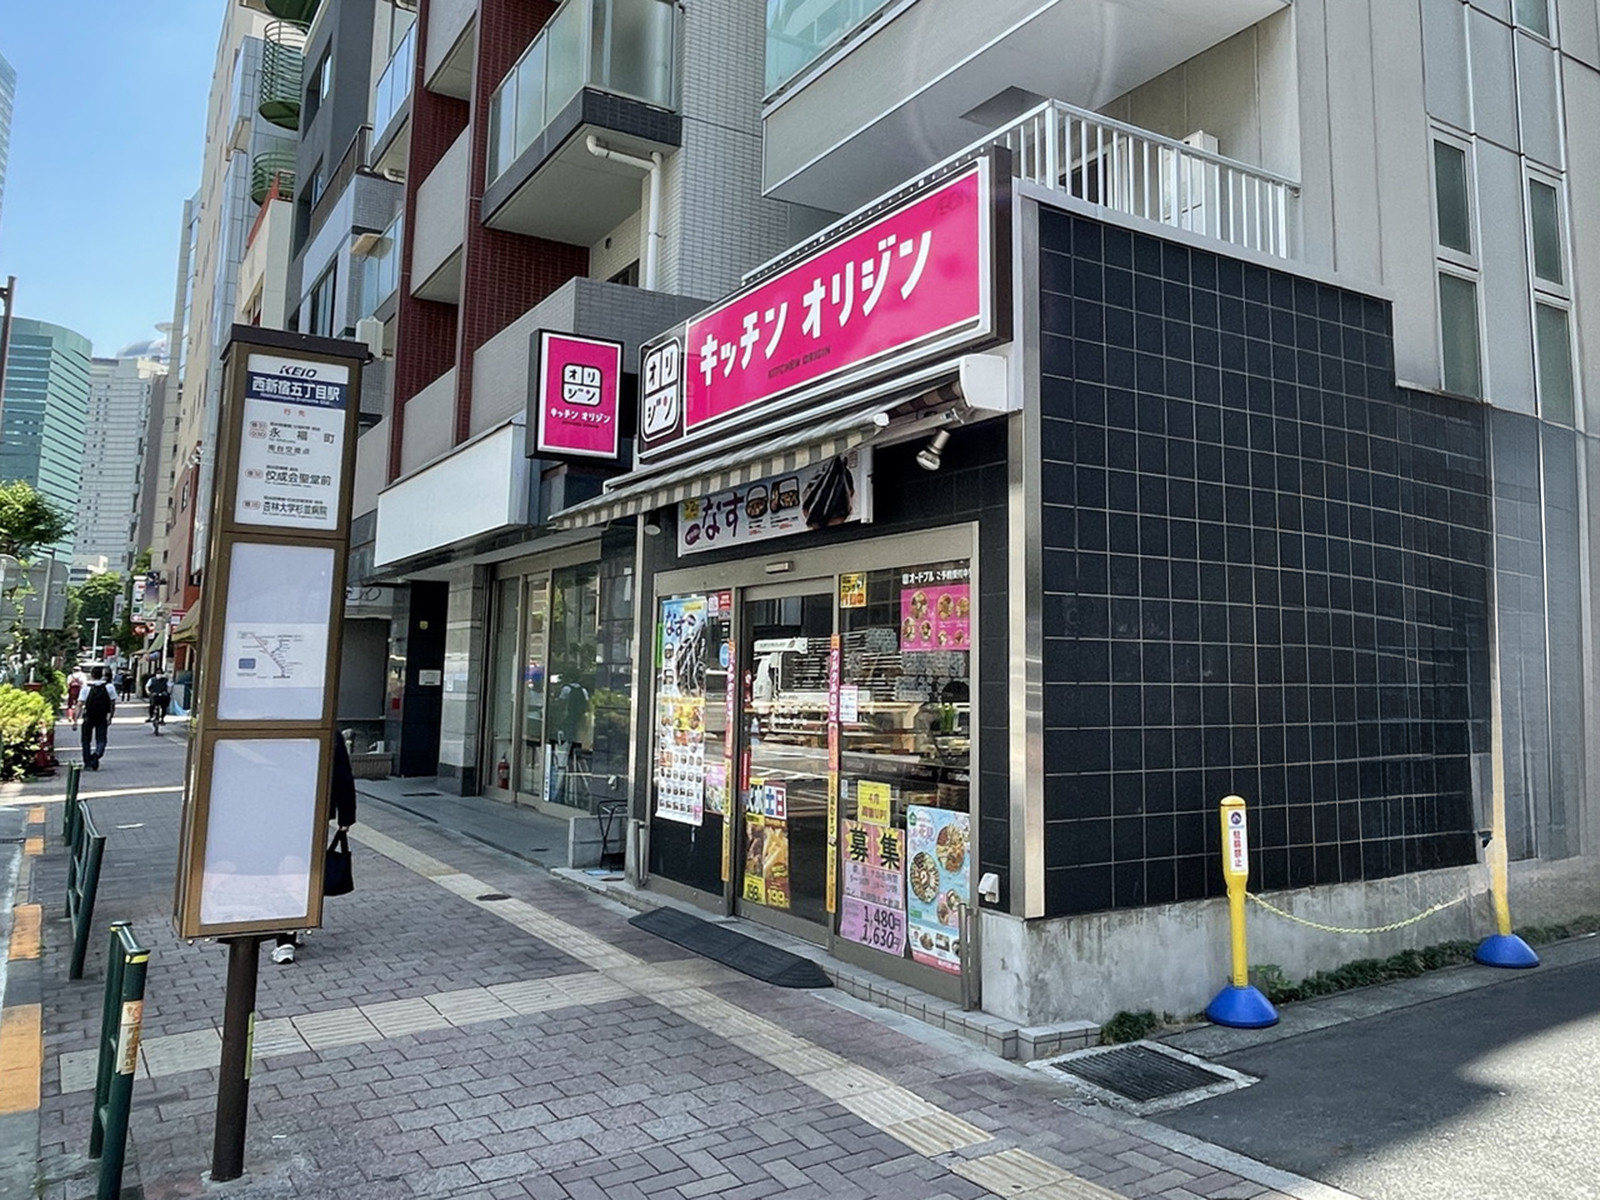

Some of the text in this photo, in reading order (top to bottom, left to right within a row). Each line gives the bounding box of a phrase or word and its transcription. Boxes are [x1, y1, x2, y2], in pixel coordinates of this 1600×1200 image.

[699, 230, 932, 387] キッチン オリジン
[279, 365, 317, 378] KEIO
[252, 376, 340, 401] 西新宿五丁目駅
[550, 407, 611, 424] キッチン オリジン
[702, 491, 745, 540] なす
[849, 827, 900, 870] 募集
[863, 905, 901, 932] 1,480円
[861, 923, 901, 952] 1,630円
